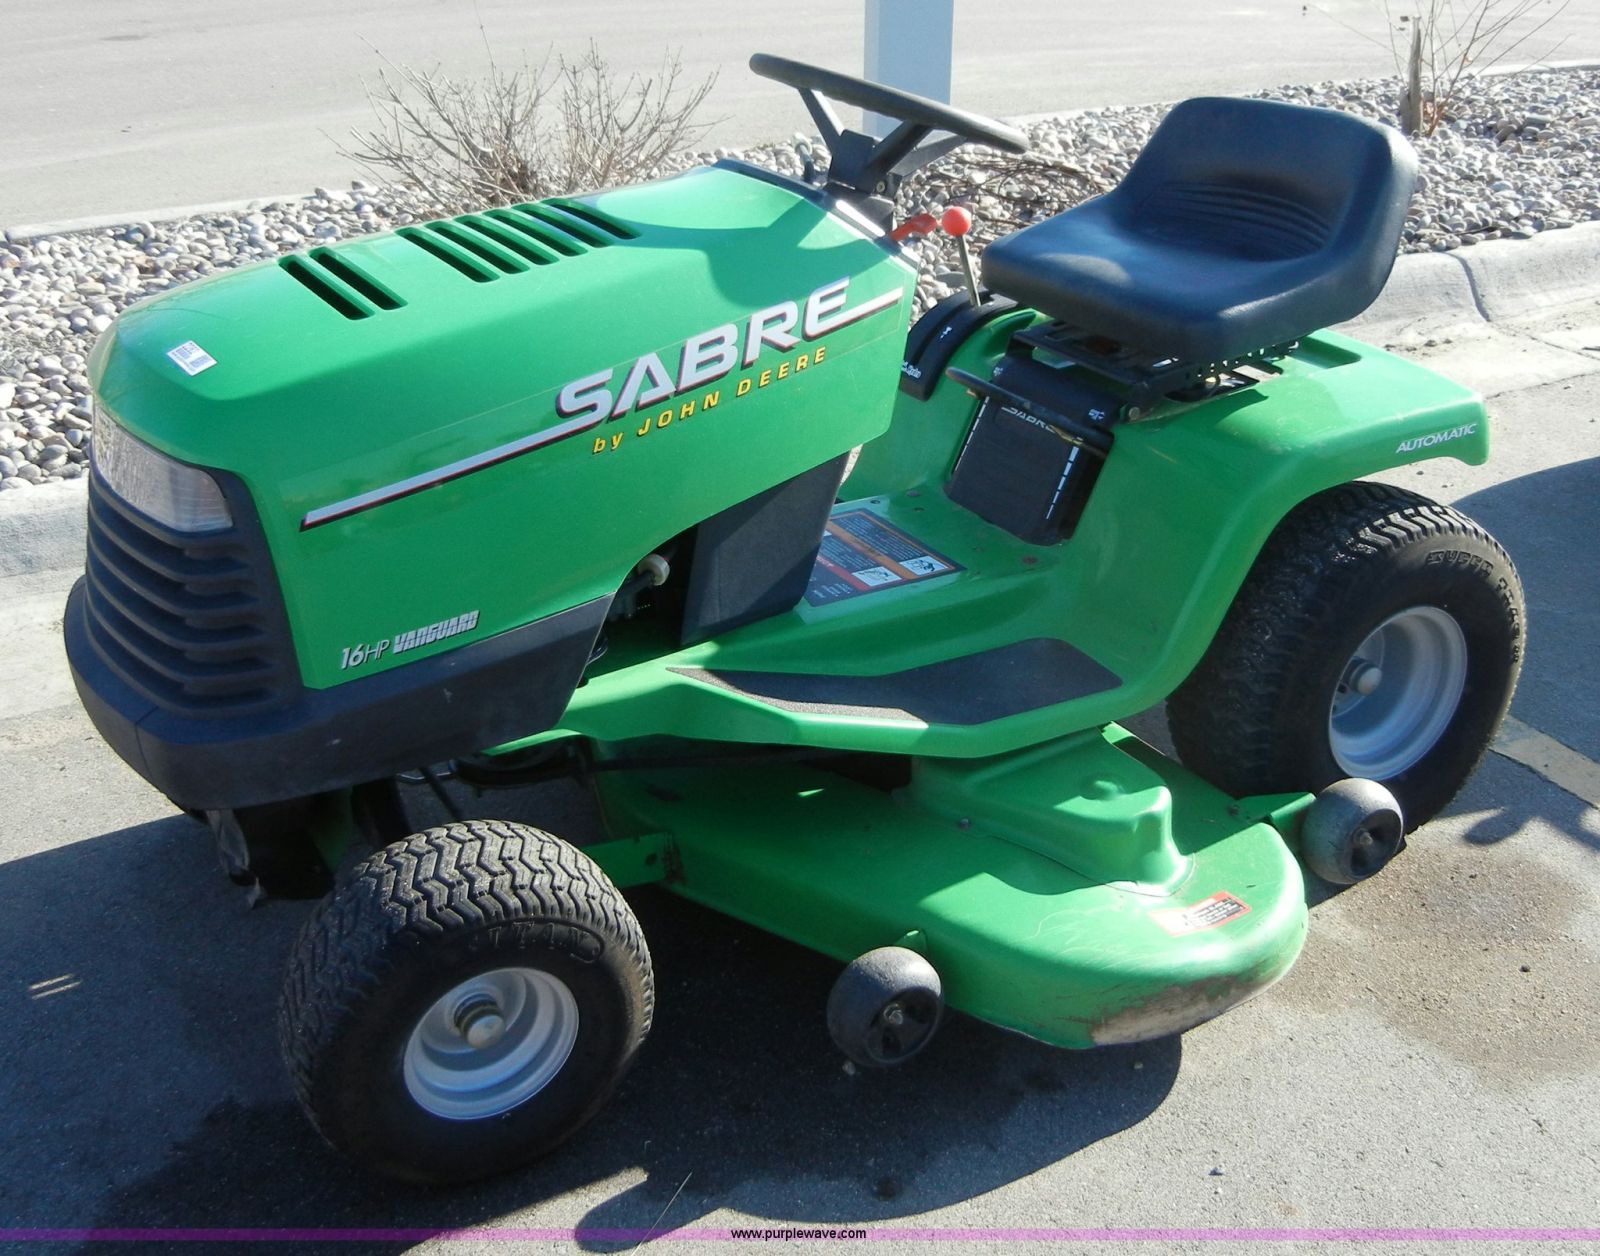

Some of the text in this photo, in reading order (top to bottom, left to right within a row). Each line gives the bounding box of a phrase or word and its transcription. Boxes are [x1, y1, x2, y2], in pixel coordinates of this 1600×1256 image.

[556, 276, 850, 424] SABRE
[592, 346, 827, 455] by JOHN DEERE
[1395, 423, 1478, 454] AUTOMATIC
[393, 609, 481, 654] VANGUARD
